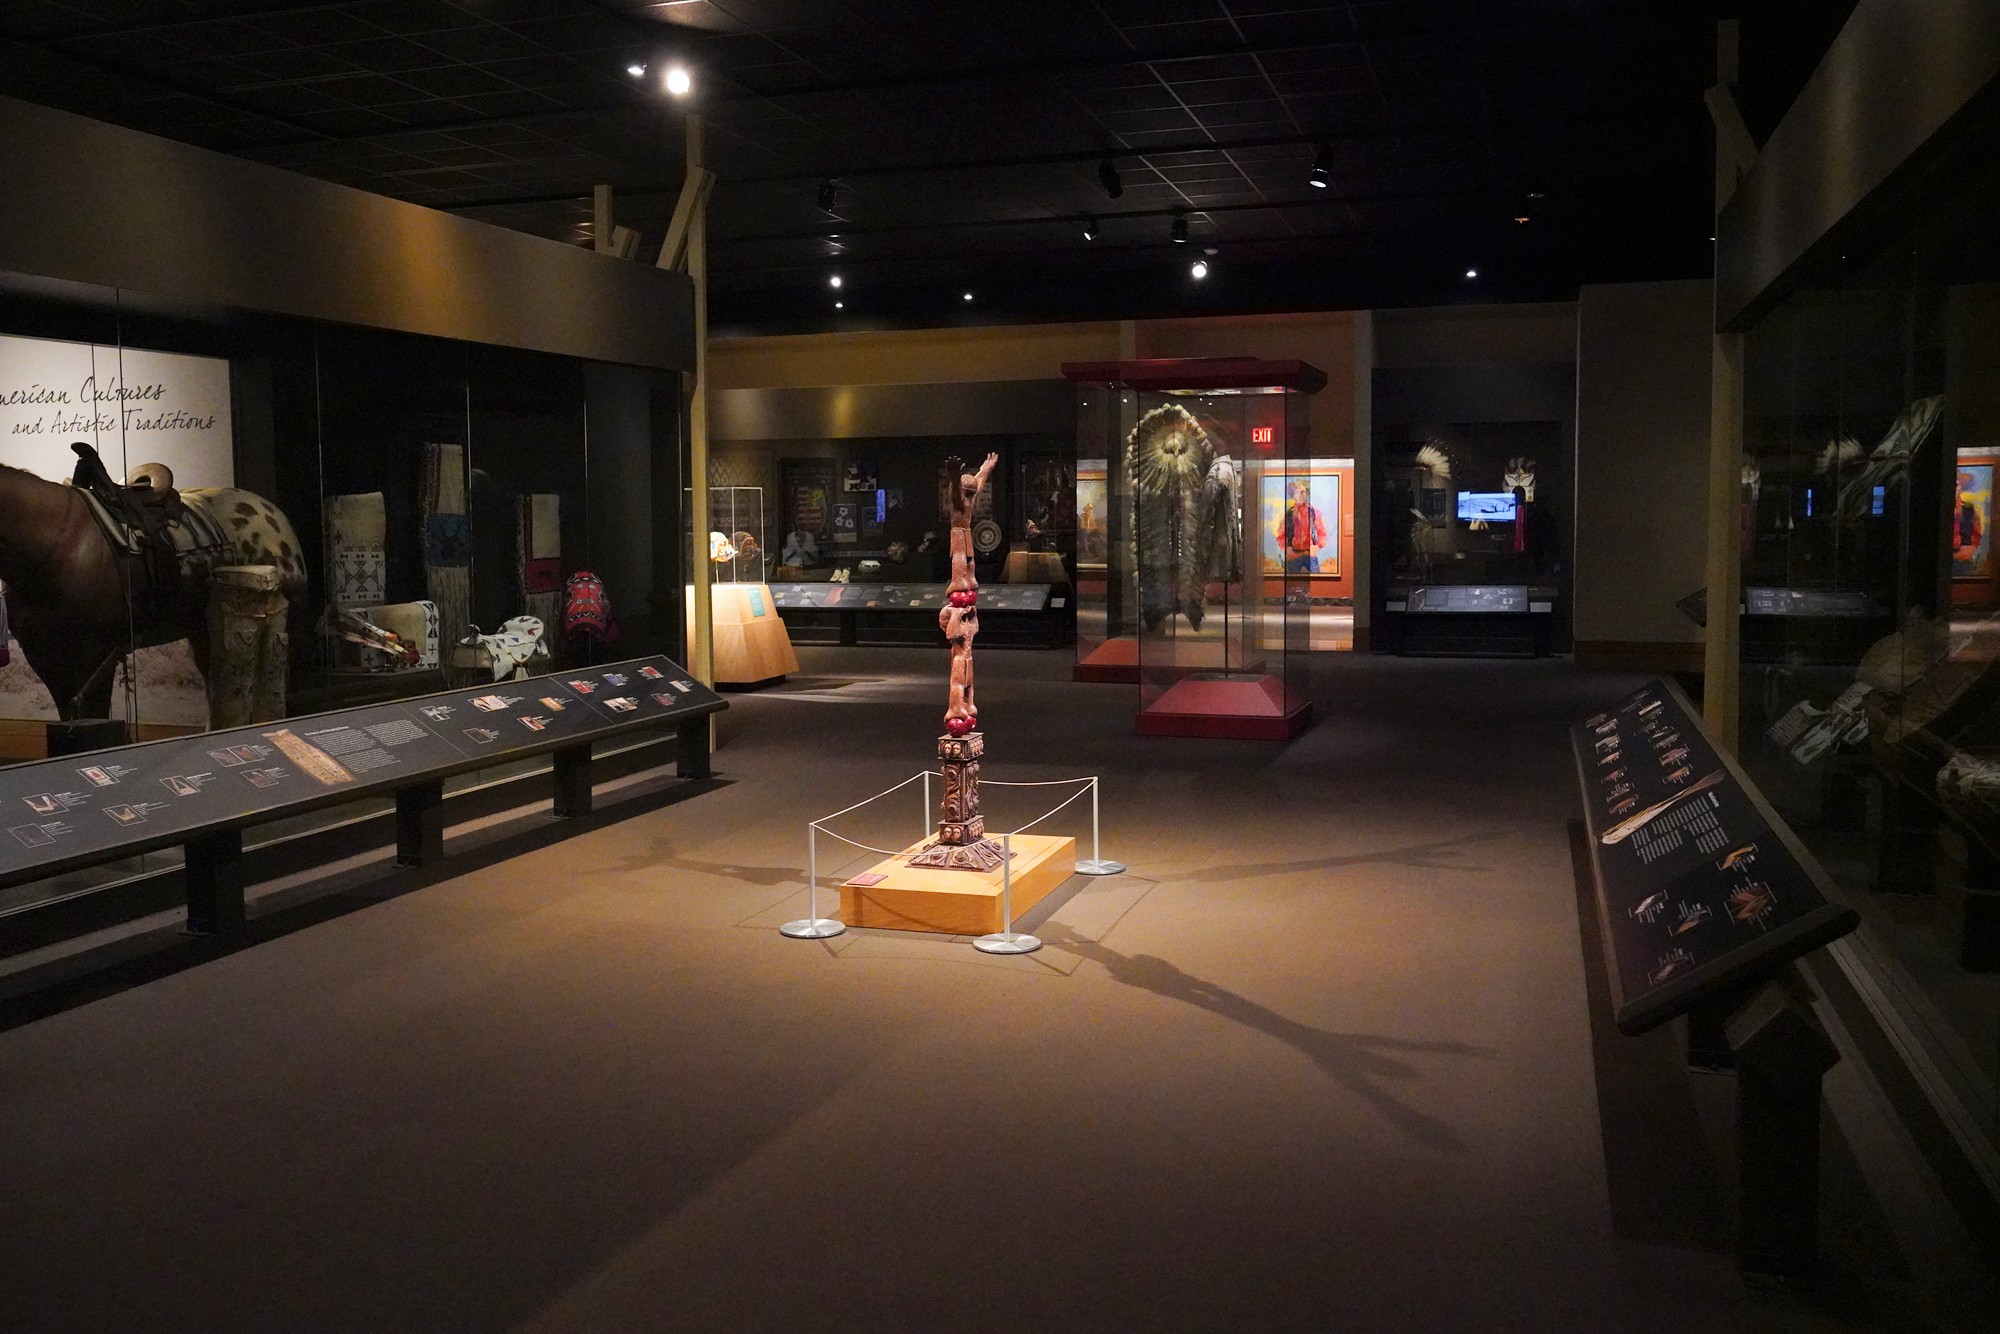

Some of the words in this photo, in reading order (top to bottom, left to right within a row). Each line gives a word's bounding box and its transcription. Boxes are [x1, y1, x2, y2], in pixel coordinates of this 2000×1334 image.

[80, 375, 167, 403] Cultures
[12, 417, 44, 435] and
[51, 409, 117, 434] Artistic
[122, 409, 217, 431] Traditions
[1252, 427, 1273, 443] EXIT
